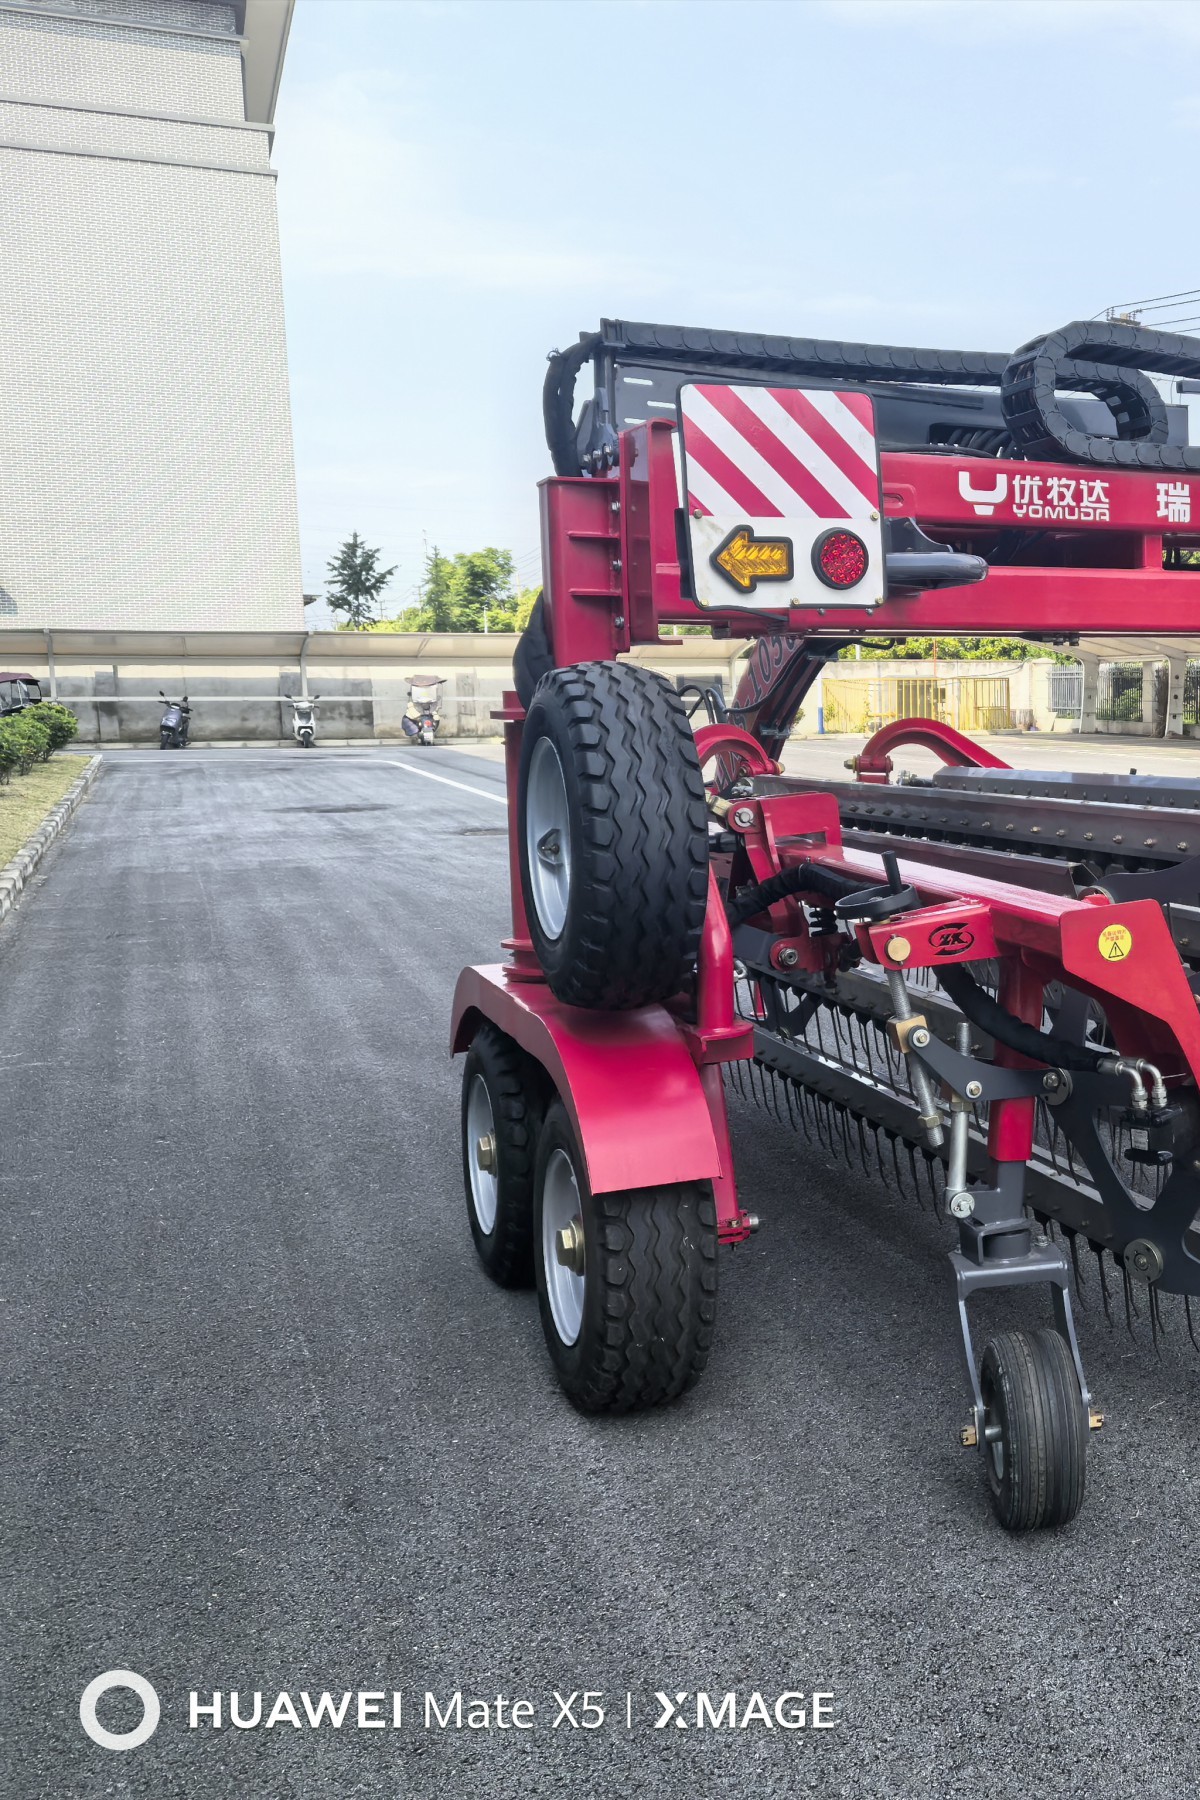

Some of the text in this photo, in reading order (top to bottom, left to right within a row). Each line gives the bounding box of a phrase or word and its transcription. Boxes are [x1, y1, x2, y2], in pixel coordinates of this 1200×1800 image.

[1012, 474, 1110, 506] 优牧达
[1012, 504, 1110, 522] YOMUDA
